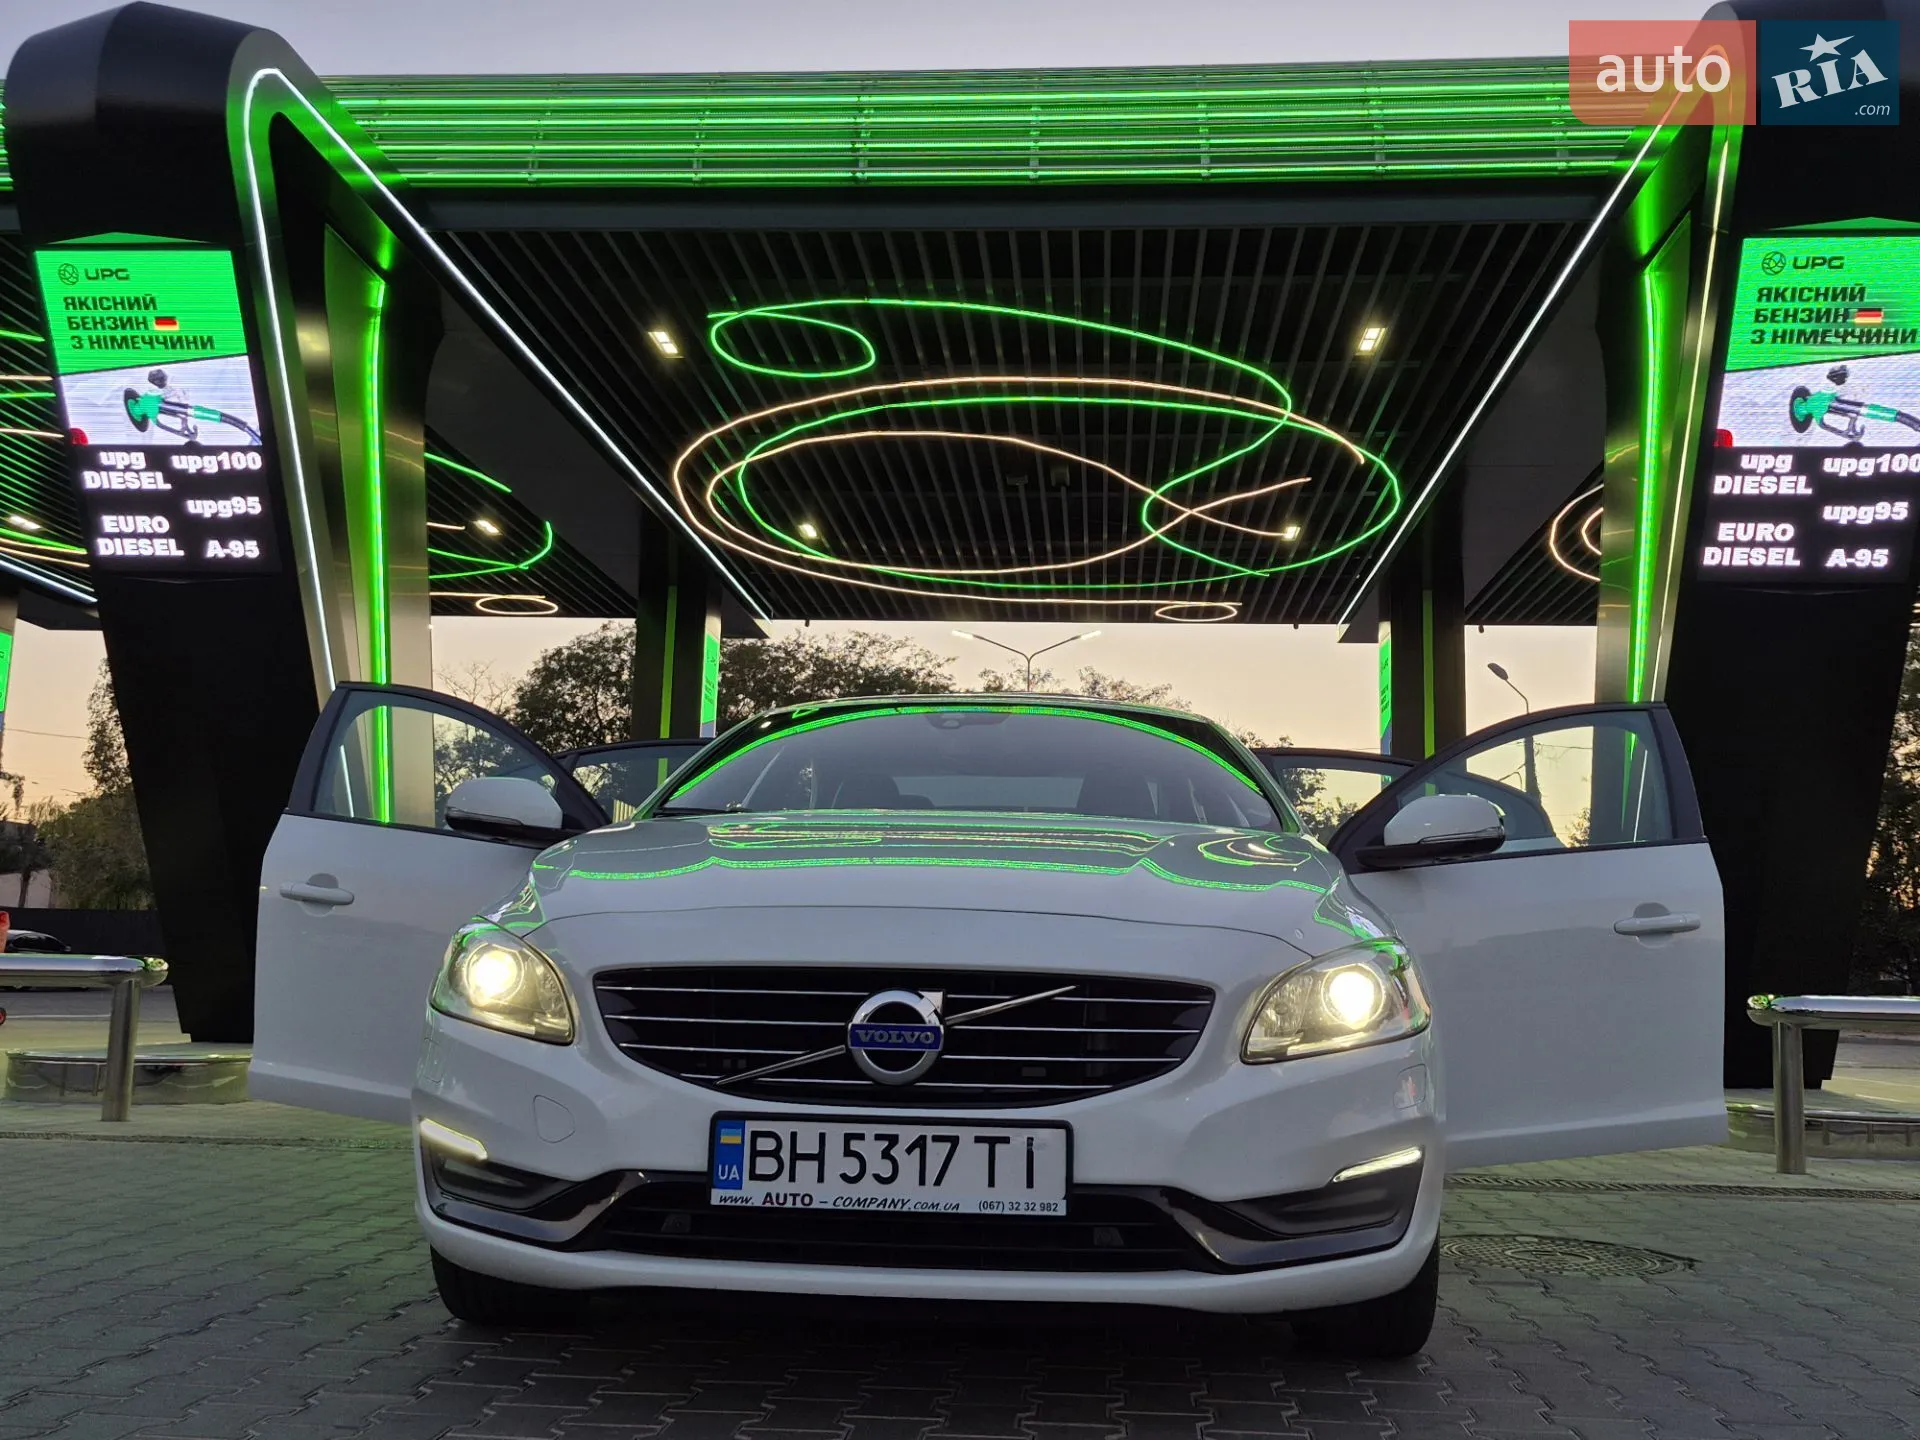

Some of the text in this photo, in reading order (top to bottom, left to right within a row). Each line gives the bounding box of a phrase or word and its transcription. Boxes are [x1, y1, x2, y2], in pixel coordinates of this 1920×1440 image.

[1792, 256, 1845, 270] UPG
[84, 268, 130, 281] UPG
[63, 293, 158, 311] ЯКІСНИЙ
[1757, 283, 1866, 303] ЯКІСНИЙ
[67, 316, 149, 331] БЕНЗИН
[1753, 308, 1851, 324] БЕНЗИН
[88, 335, 216, 350] НІМЕЧЧИНИ
[1770, 328, 1918, 345] НІМЕЧЧИНИ
[99, 451, 147, 470] upg
[171, 451, 262, 473] upg100
[1740, 454, 1793, 473] upg
[83, 471, 172, 490] DIESEL
[1713, 475, 1813, 495] DIESEL
[187, 496, 262, 517] upg95
[1822, 501, 1909, 524] upg95
[102, 516, 170, 533] EURO
[1717, 523, 1795, 541] EURO
[97, 538, 185, 556] DIESEL
[1703, 547, 1800, 566] DIESEL
[855, 1029, 935, 1044] VOLVO
[748, 1130, 826, 1183] BH
[839, 1132, 961, 1187] 5317
[718, 1164, 740, 1181] UA
[761, 1192, 814, 1207] AUTO
[978, 1200, 1005, 1212] (067)
[1008, 1201, 1021, 1212] 32
[1023, 1202, 1037, 1212] 32
